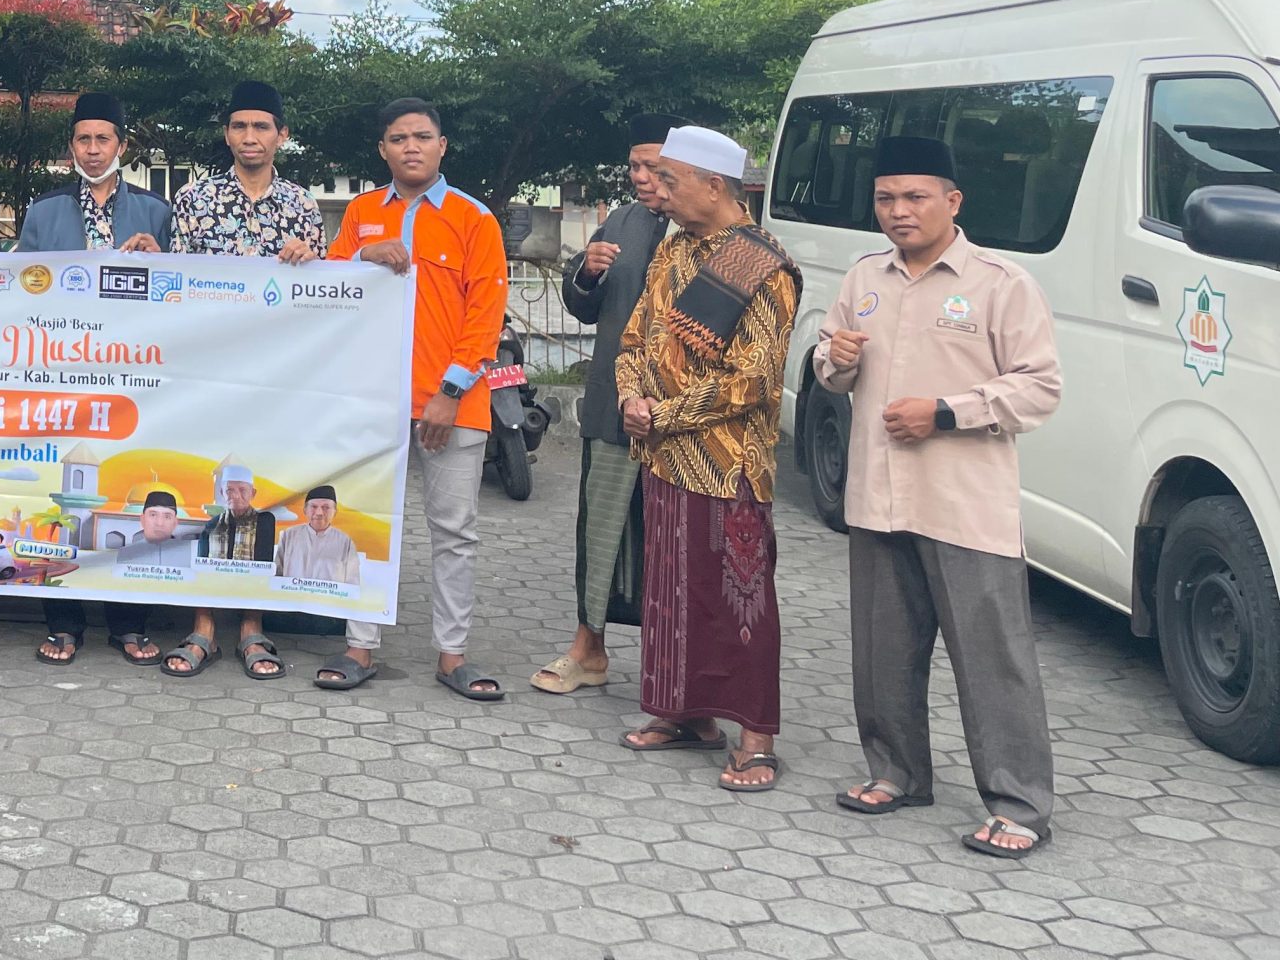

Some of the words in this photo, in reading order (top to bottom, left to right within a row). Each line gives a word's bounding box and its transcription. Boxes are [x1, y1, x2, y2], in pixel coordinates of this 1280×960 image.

[188, 277, 245, 293] Kemenag
[291, 281, 364, 301] pusaka
[188, 288, 256, 304] Berdampak
[27, 315, 67, 331] Masjid
[69, 318, 105, 333] Besar
[2, 325, 166, 368] Muslimin
[24, 369, 55, 385] Kab.
[59, 371, 116, 387] Lombok
[120, 373, 161, 389] Timur
[19, 398, 78, 432] 1447
[90, 401, 112, 433] H
[19, 543, 70, 558] MUDIK
[291, 577, 338, 590] Chaeruman
